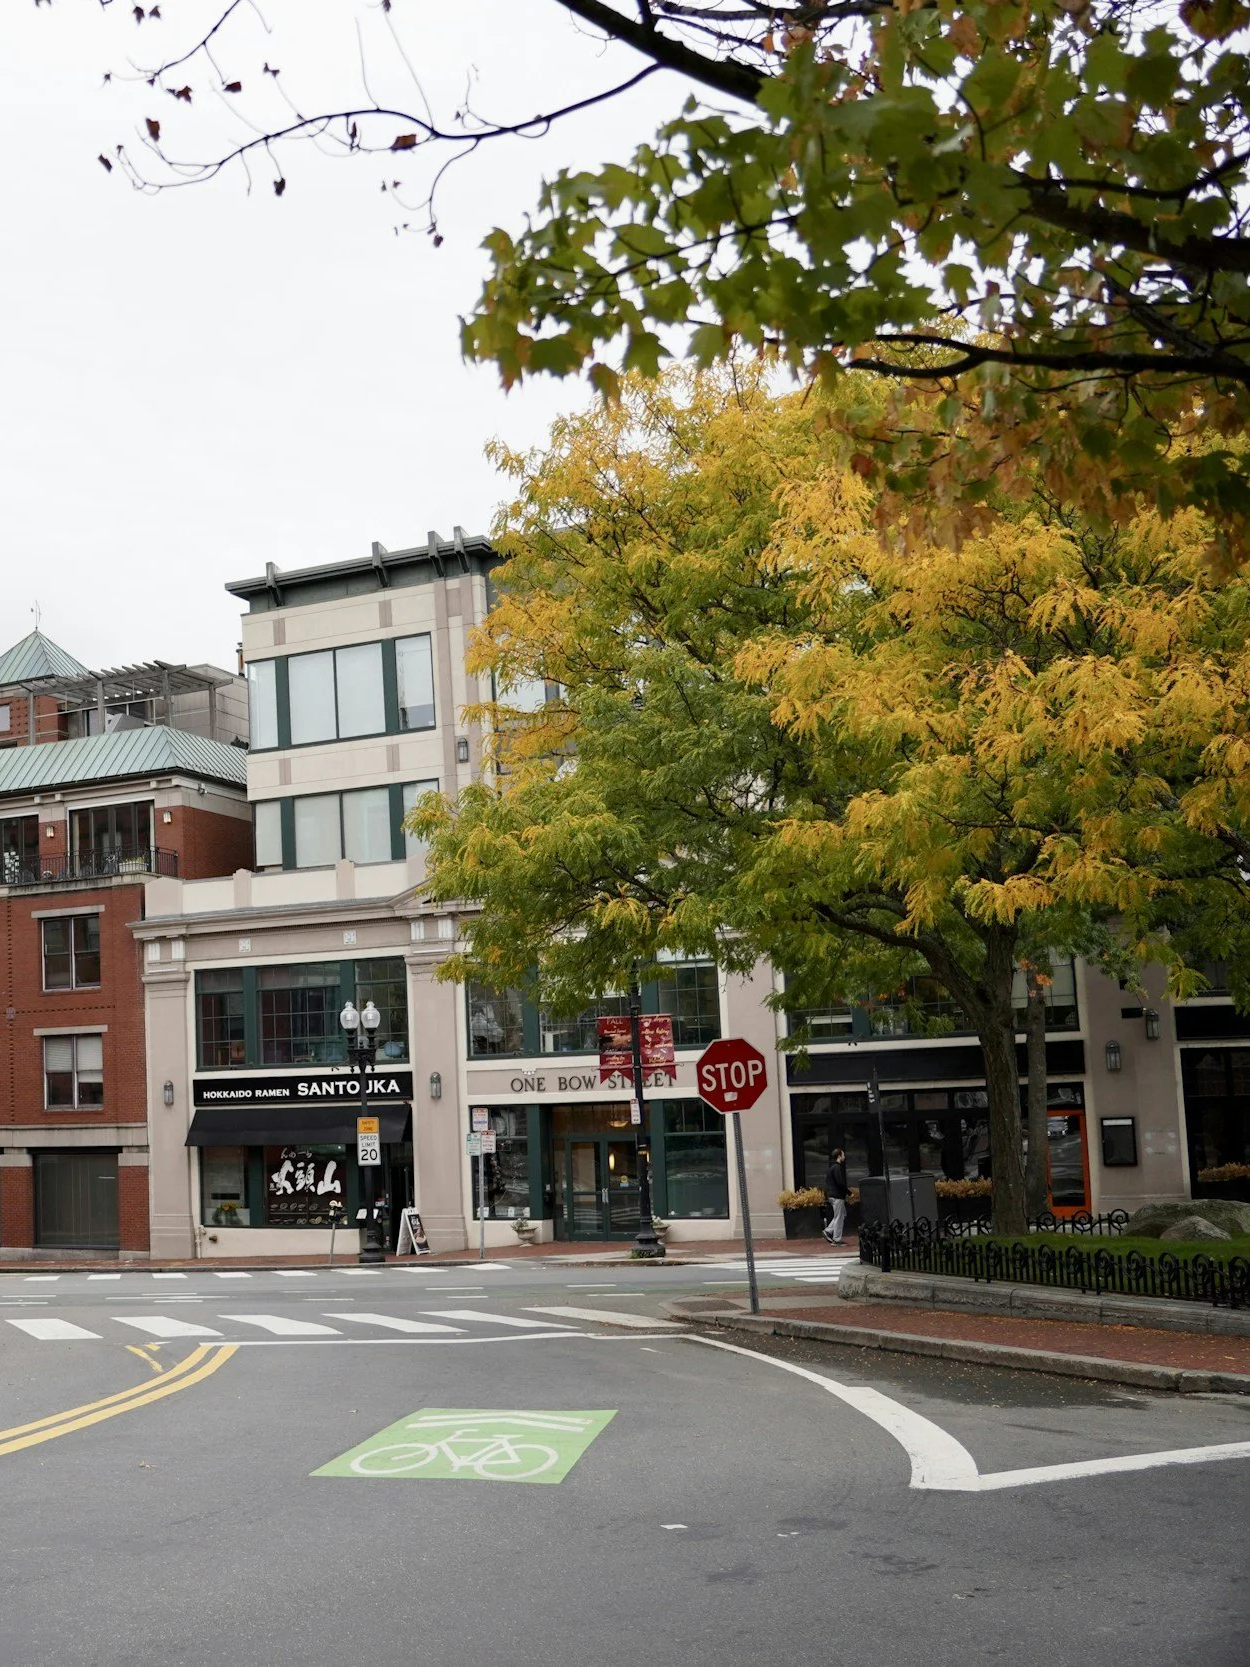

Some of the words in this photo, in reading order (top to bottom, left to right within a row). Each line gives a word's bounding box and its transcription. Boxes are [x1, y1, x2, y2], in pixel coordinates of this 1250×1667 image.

[510, 1077, 546, 1092] ONE
[557, 1075, 597, 1090] BOW
[701, 1060, 763, 1092] STOP
[203, 1089, 253, 1099] HOKKAIDO
[255, 1088, 290, 1097] RAMEN
[360, 1148, 378, 1161] 20
